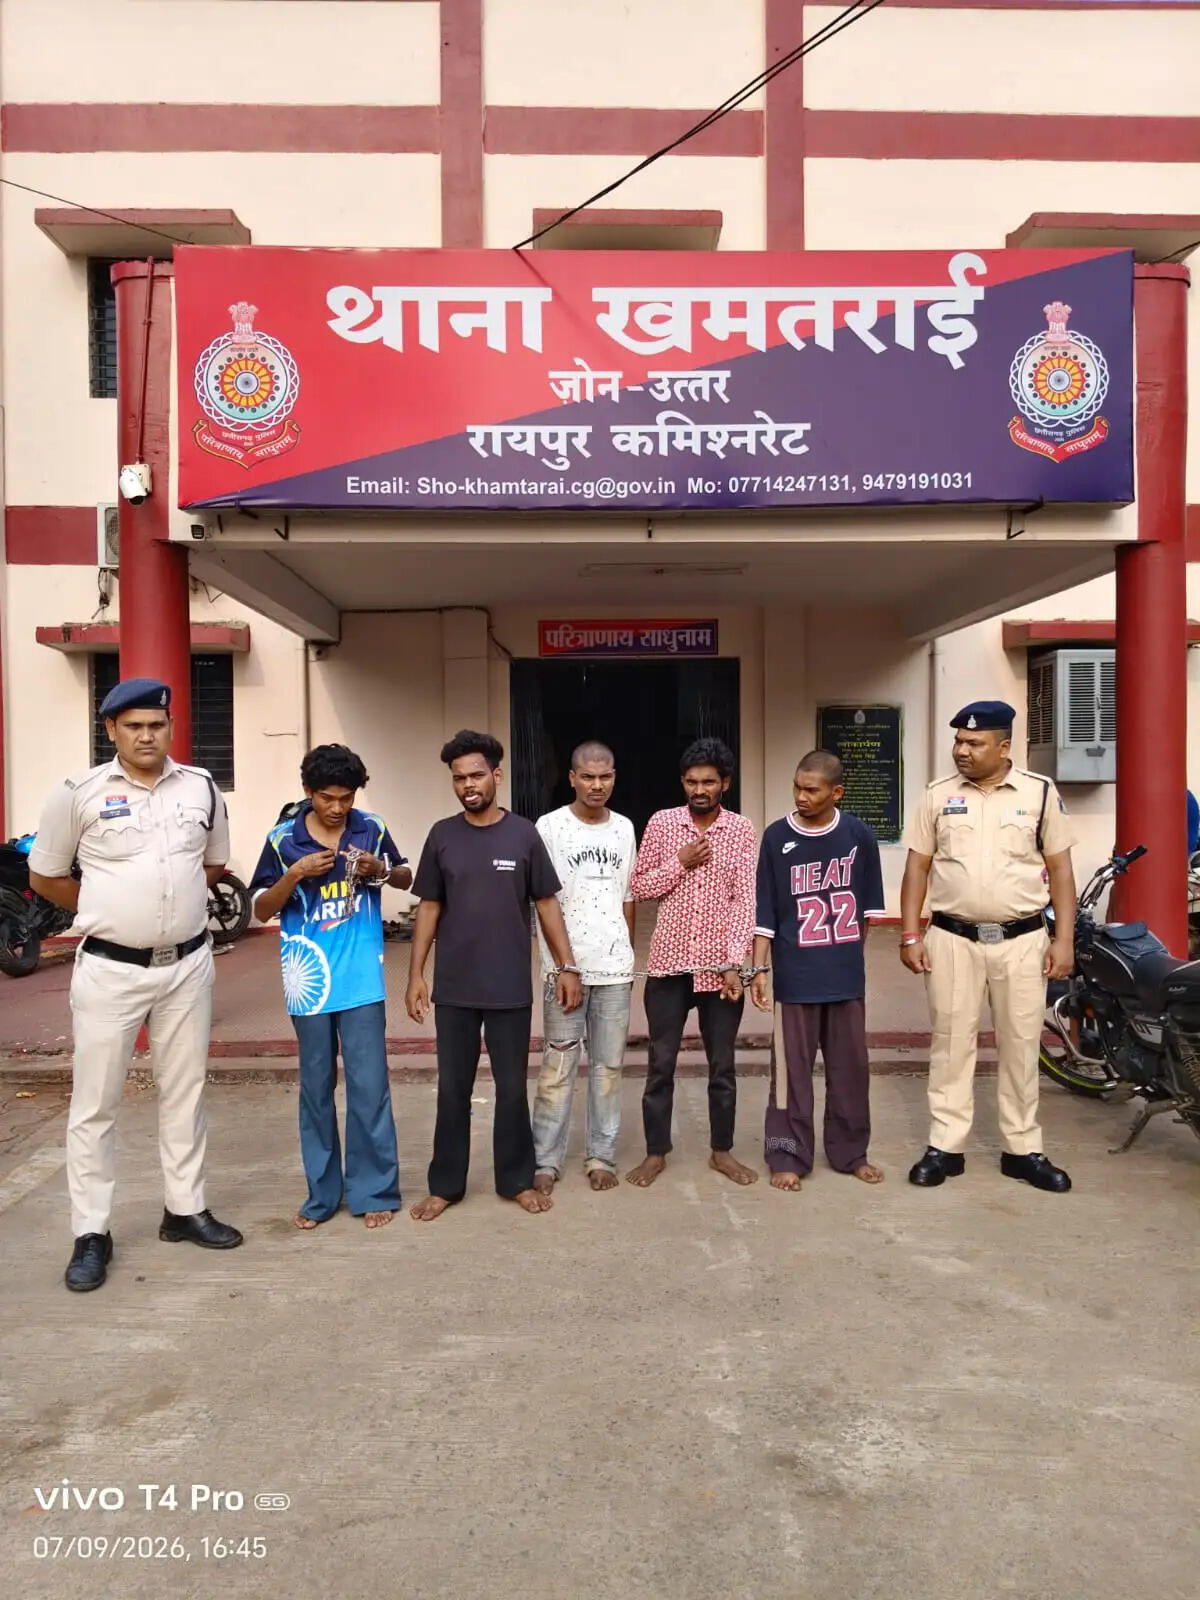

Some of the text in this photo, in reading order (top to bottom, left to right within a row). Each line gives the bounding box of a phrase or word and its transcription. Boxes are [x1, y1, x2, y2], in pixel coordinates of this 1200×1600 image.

[327, 252, 988, 370] थाना खमतराई
[466, 410, 811, 471] रायपुर कमिश्नरेट
[346, 472, 973, 499] Email: Sho-khamtarai.cg@gov.in Mo: 07714247131, 9479191031
[545, 624, 713, 652] परित्राणाय साधुनाम
[790, 846, 858, 895] HEAT
[797, 890, 861, 947] 22
